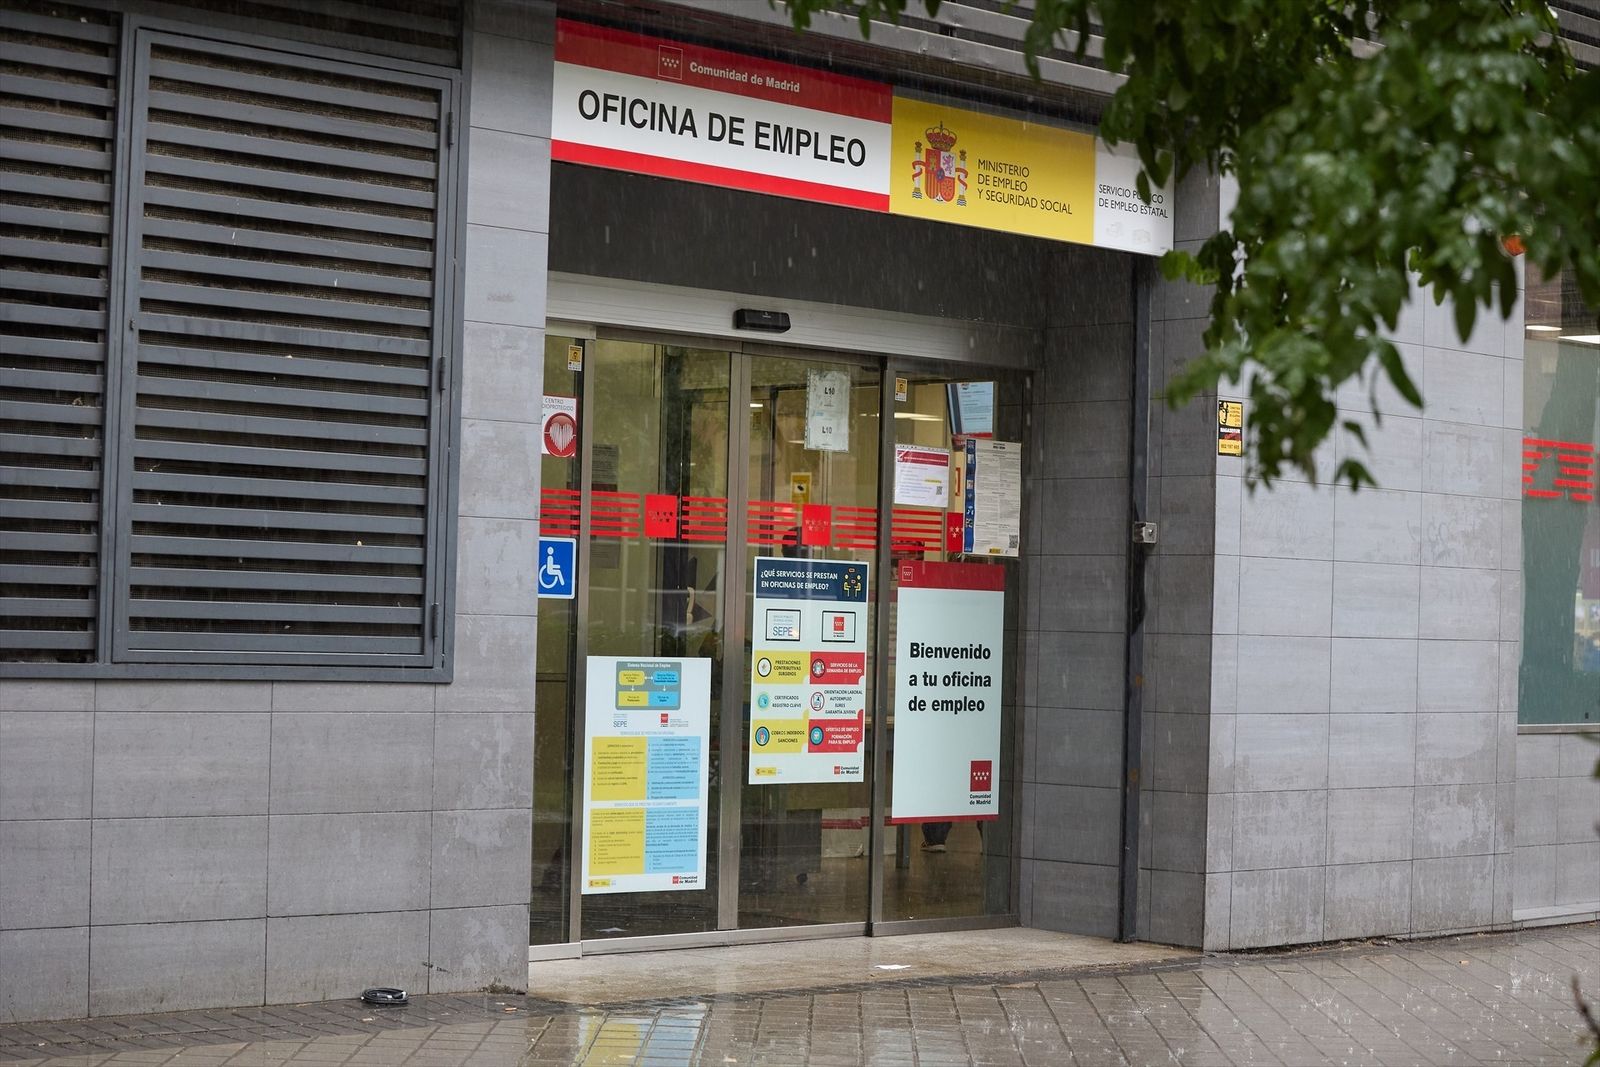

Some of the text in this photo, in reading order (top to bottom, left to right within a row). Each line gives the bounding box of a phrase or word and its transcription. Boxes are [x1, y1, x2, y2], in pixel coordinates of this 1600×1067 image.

[690, 62, 800, 93] Comunidad de Madrid
[578, 89, 866, 167] OFICINA DE EMPLEO
[978, 158, 1030, 178] MINISTERIO
[977, 173, 1028, 192] DE EMPLEO
[1098, 183, 1131, 199] SERVICIO
[977, 188, 1073, 215] Y SEGURIDAD SOCIAL
[1098, 197, 1169, 219] DE EMPLEO ESTATAL
[760, 569, 838, 581] ¿QUÉ SERVICIOS SE PRESTAN
[769, 580, 796, 590] OFICINAS
[796, 581, 804, 590] DE
[804, 582, 830, 591] EMPLEO?
[772, 626, 793, 637] SEPE
[909, 642, 992, 660] Bienvenido
[908, 671, 992, 688] a tu oficina
[908, 696, 985, 715] de empleo
[613, 720, 628, 728] SEPE
